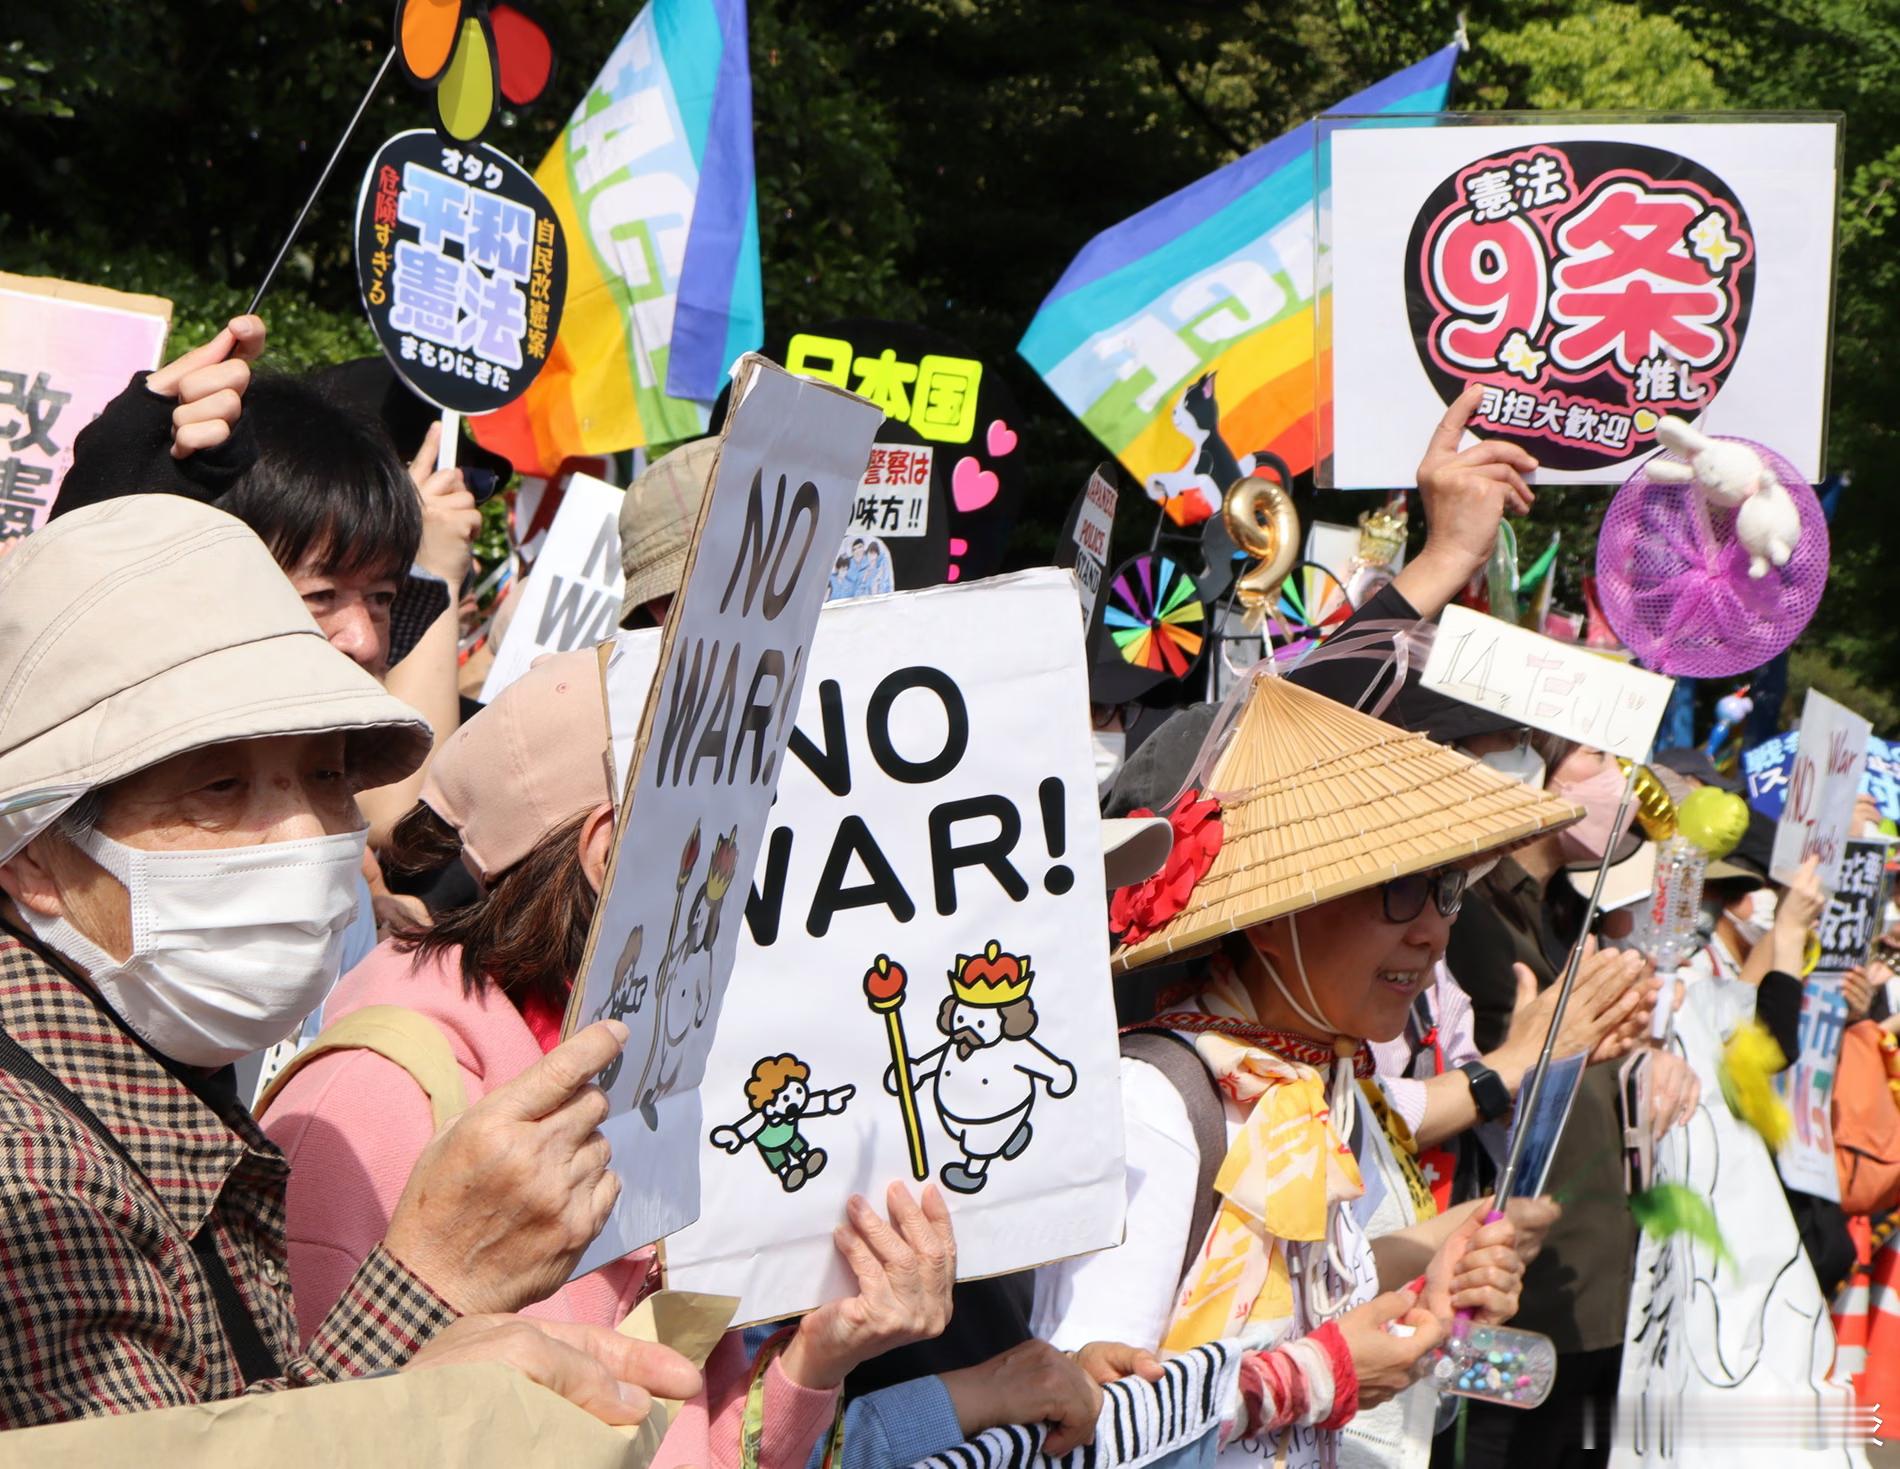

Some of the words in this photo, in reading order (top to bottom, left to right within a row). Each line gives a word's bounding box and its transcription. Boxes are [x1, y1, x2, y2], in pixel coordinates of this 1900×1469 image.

[441, 147, 504, 190] オタク
[1466, 157, 1568, 223] 憲法
[369, 164, 400, 305] 危険すぎる
[398, 161, 536, 284] 平和
[388, 238, 529, 371] 憲法
[527, 218, 556, 360] 自民改憲案
[1432, 181, 1728, 370] 9条
[401, 335, 511, 392] まもりにきた
[1634, 359, 1707, 401] 推し
[864, 449, 930, 486] 警察は
[581, 512, 625, 588] N
[719, 467, 820, 621] NO
[848, 495, 923, 532] 味方!!
[535, 574, 624, 651] WA
[656, 636, 803, 789] WAR!
